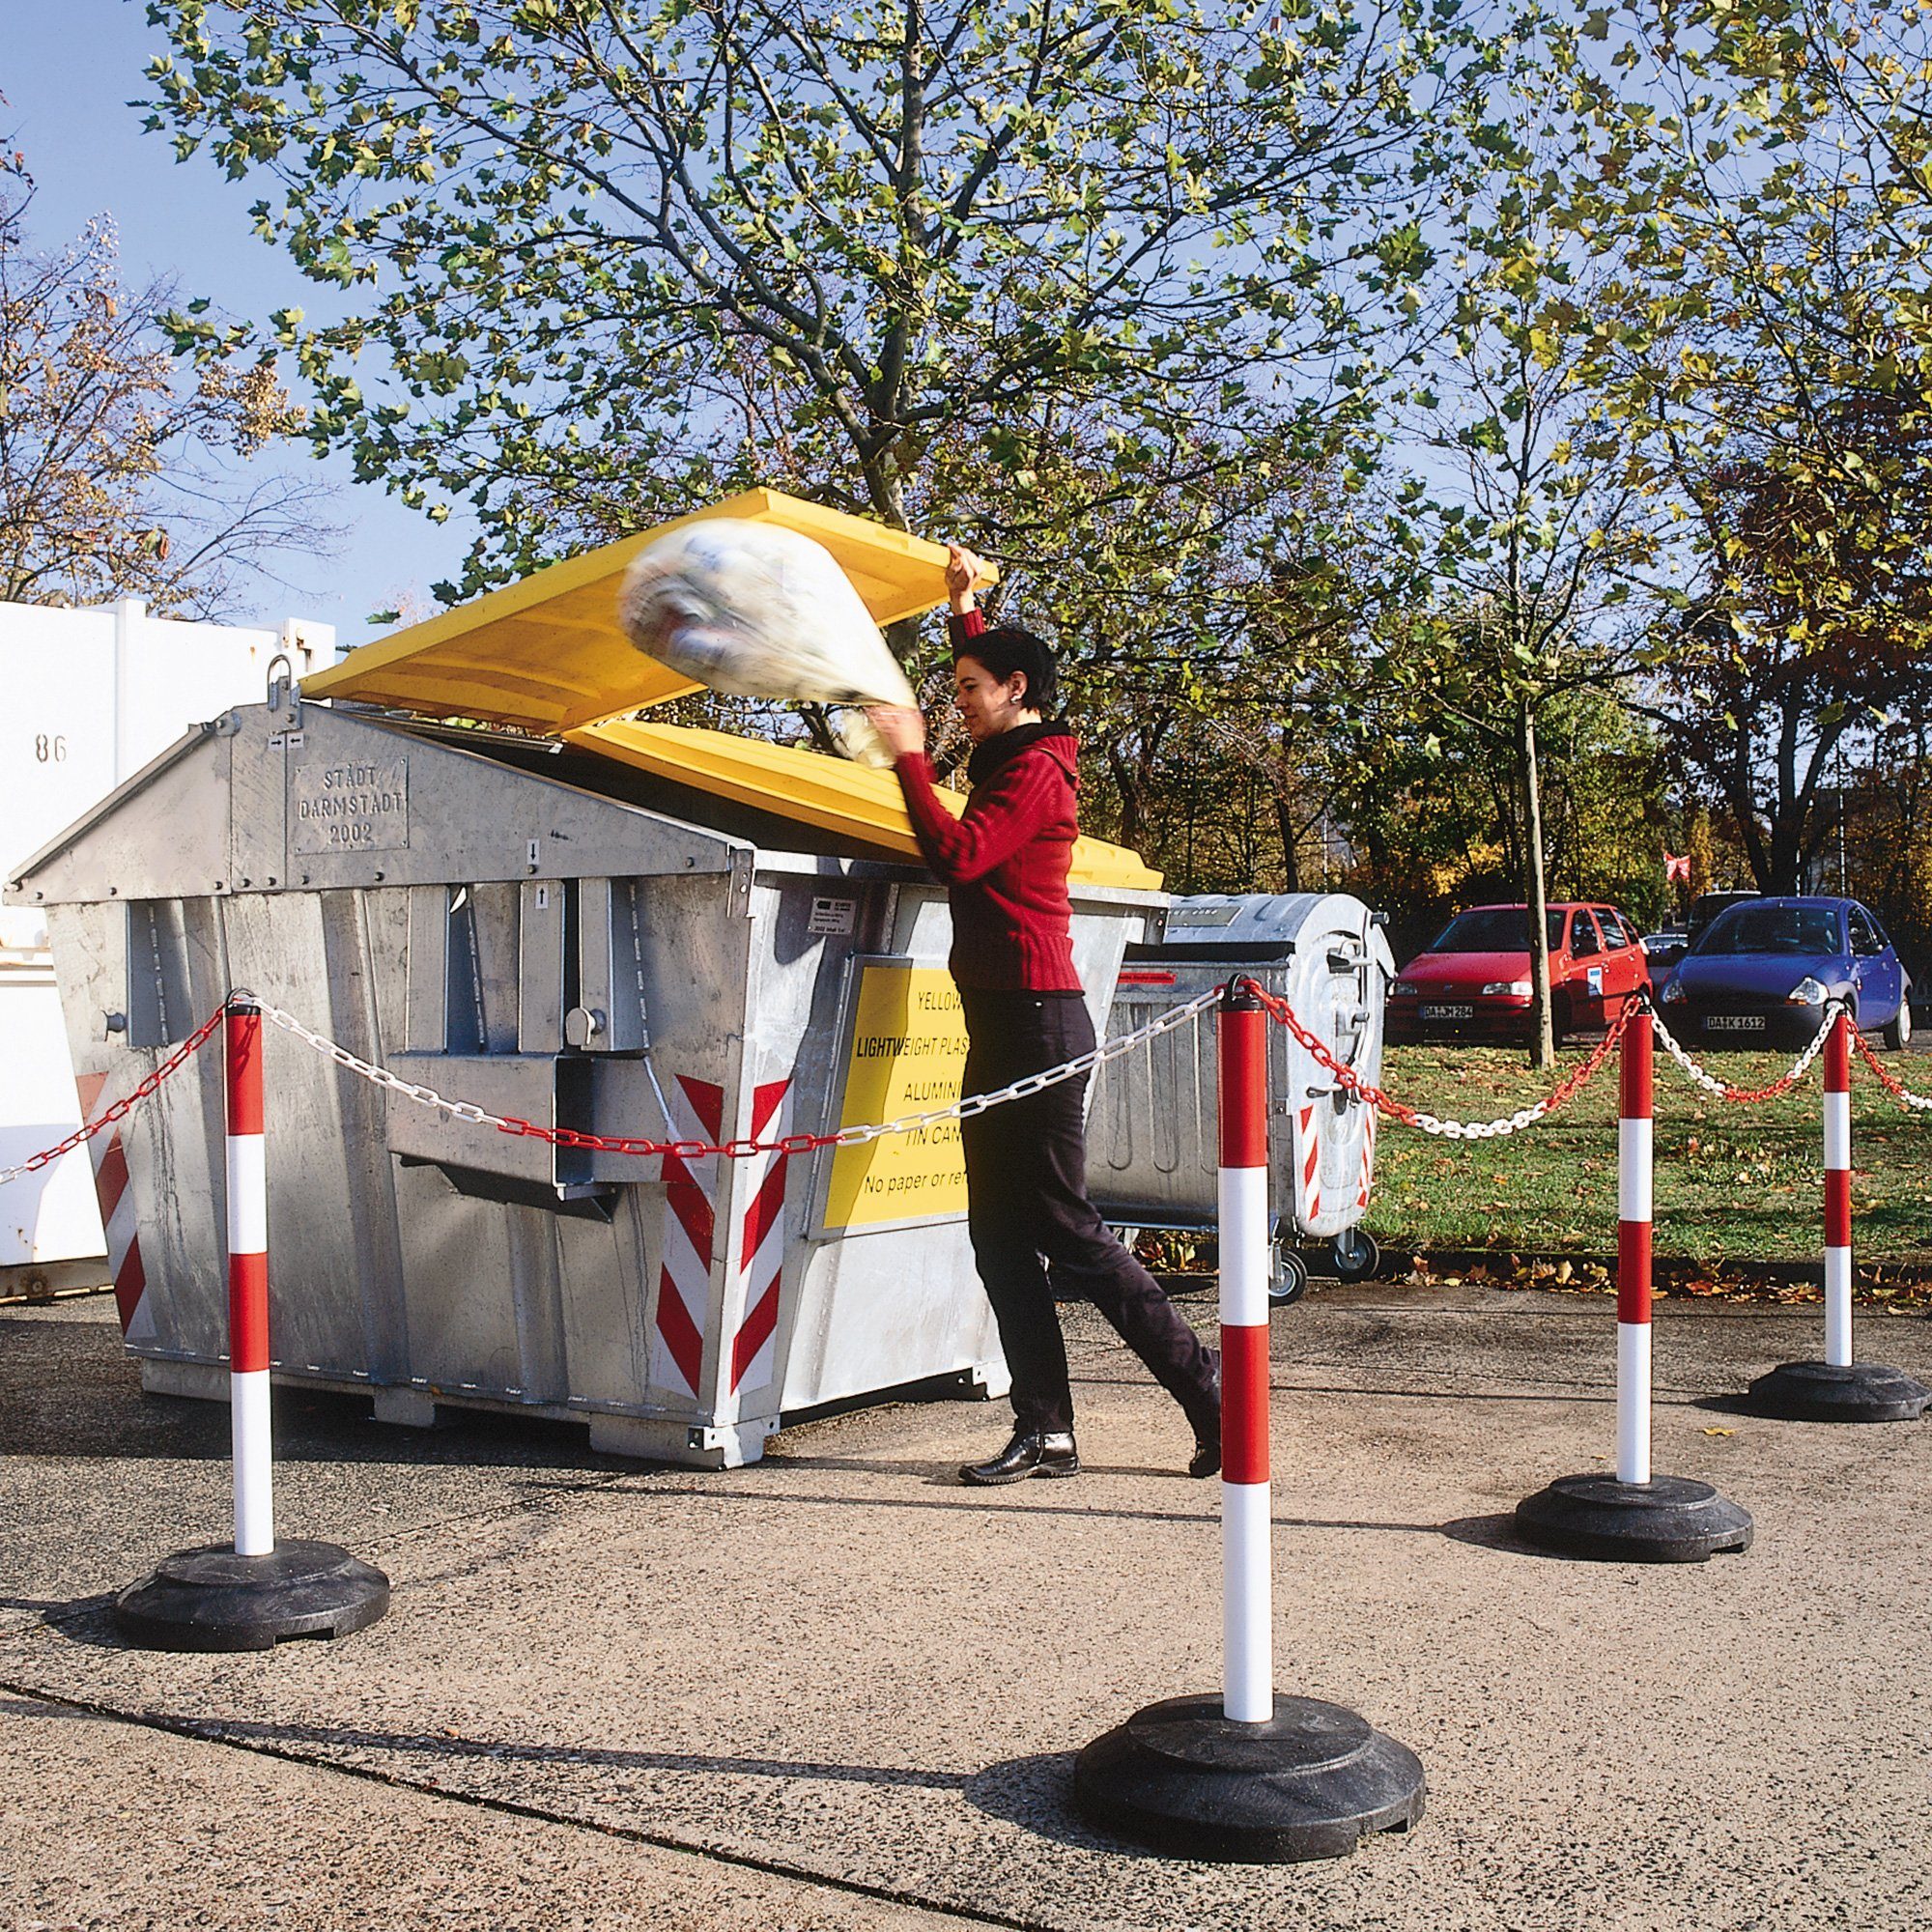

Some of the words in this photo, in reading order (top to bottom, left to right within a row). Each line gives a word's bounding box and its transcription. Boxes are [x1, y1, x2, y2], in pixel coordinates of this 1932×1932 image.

[36, 733, 67, 763] 86
[324, 766, 377, 791] STADT
[298, 791, 403, 821] DARMSTADT
[328, 822, 374, 845] 2002
[918, 991, 961, 1010] YELLOW
[1709, 1017, 1722, 1029] DA
[1728, 1017, 1736, 1029] K
[1738, 1017, 1765, 1029] 1612
[856, 1037, 938, 1058] LIGHTWEIGHT
[939, 1037, 969, 1055] PLAS
[905, 1126, 929, 1146] TIN
[931, 1125, 962, 1145] CAN
[864, 1174, 884, 1194] No
[887, 1174, 927, 1196] paper
[931, 1171, 946, 1187] or
